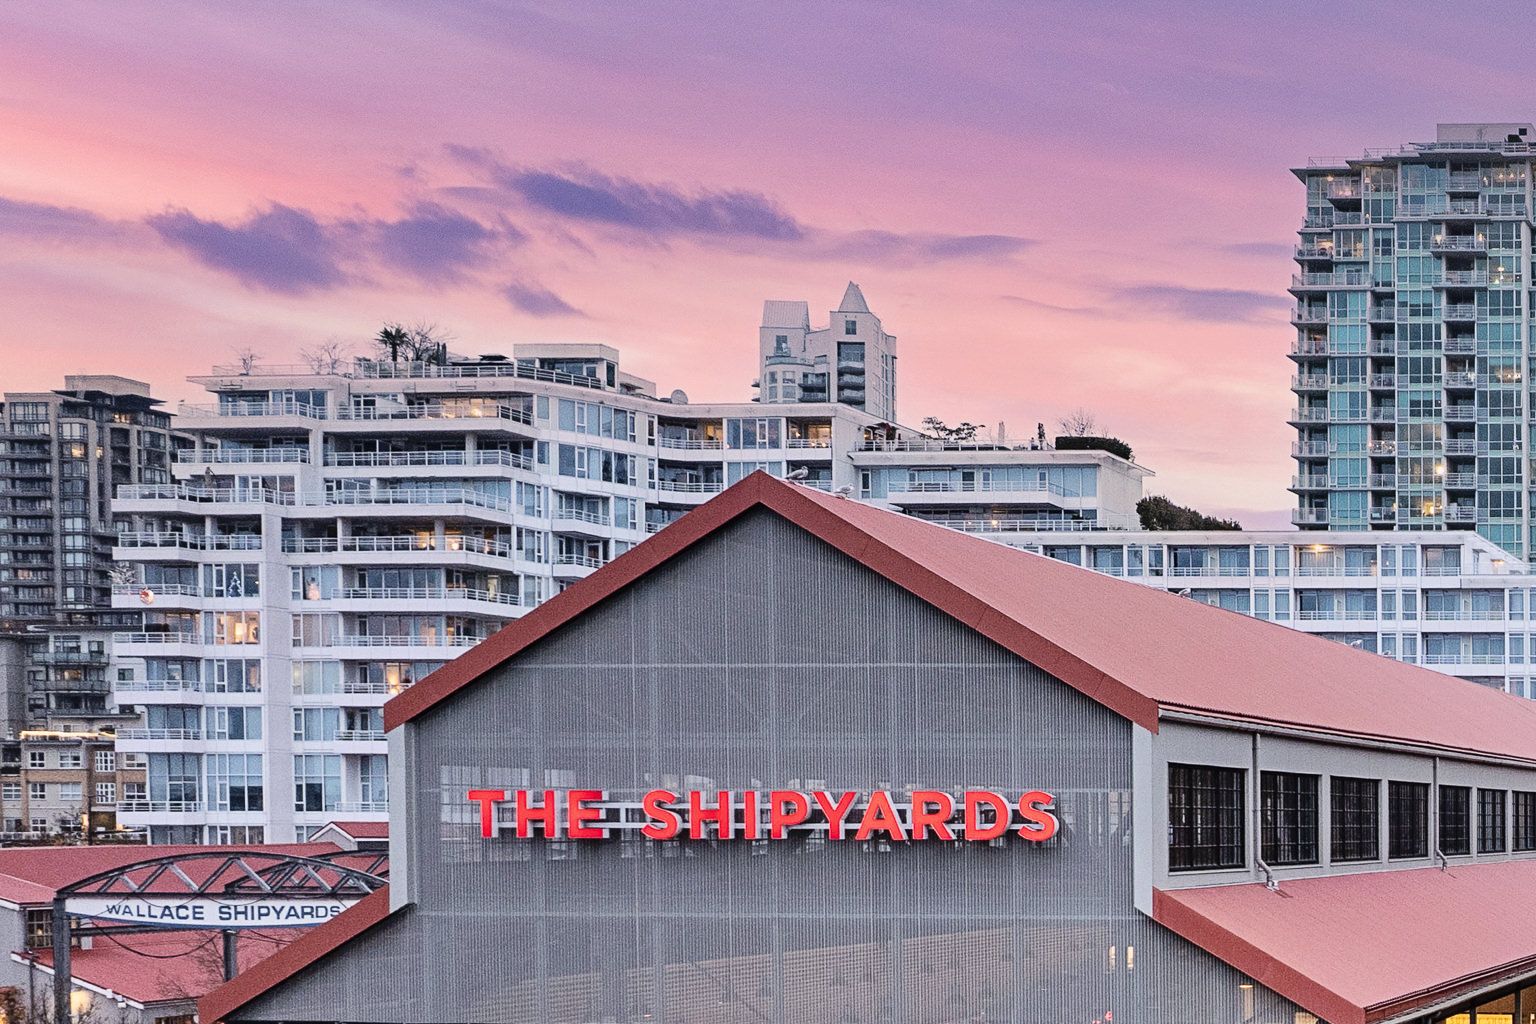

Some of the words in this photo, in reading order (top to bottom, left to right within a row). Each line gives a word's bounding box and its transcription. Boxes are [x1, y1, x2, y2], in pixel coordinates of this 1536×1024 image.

[467, 789, 609, 840] THE
[641, 789, 1060, 841] SHIPYARDS
[106, 903, 205, 921] WALLACE
[218, 904, 343, 922] SHIPYARDS
